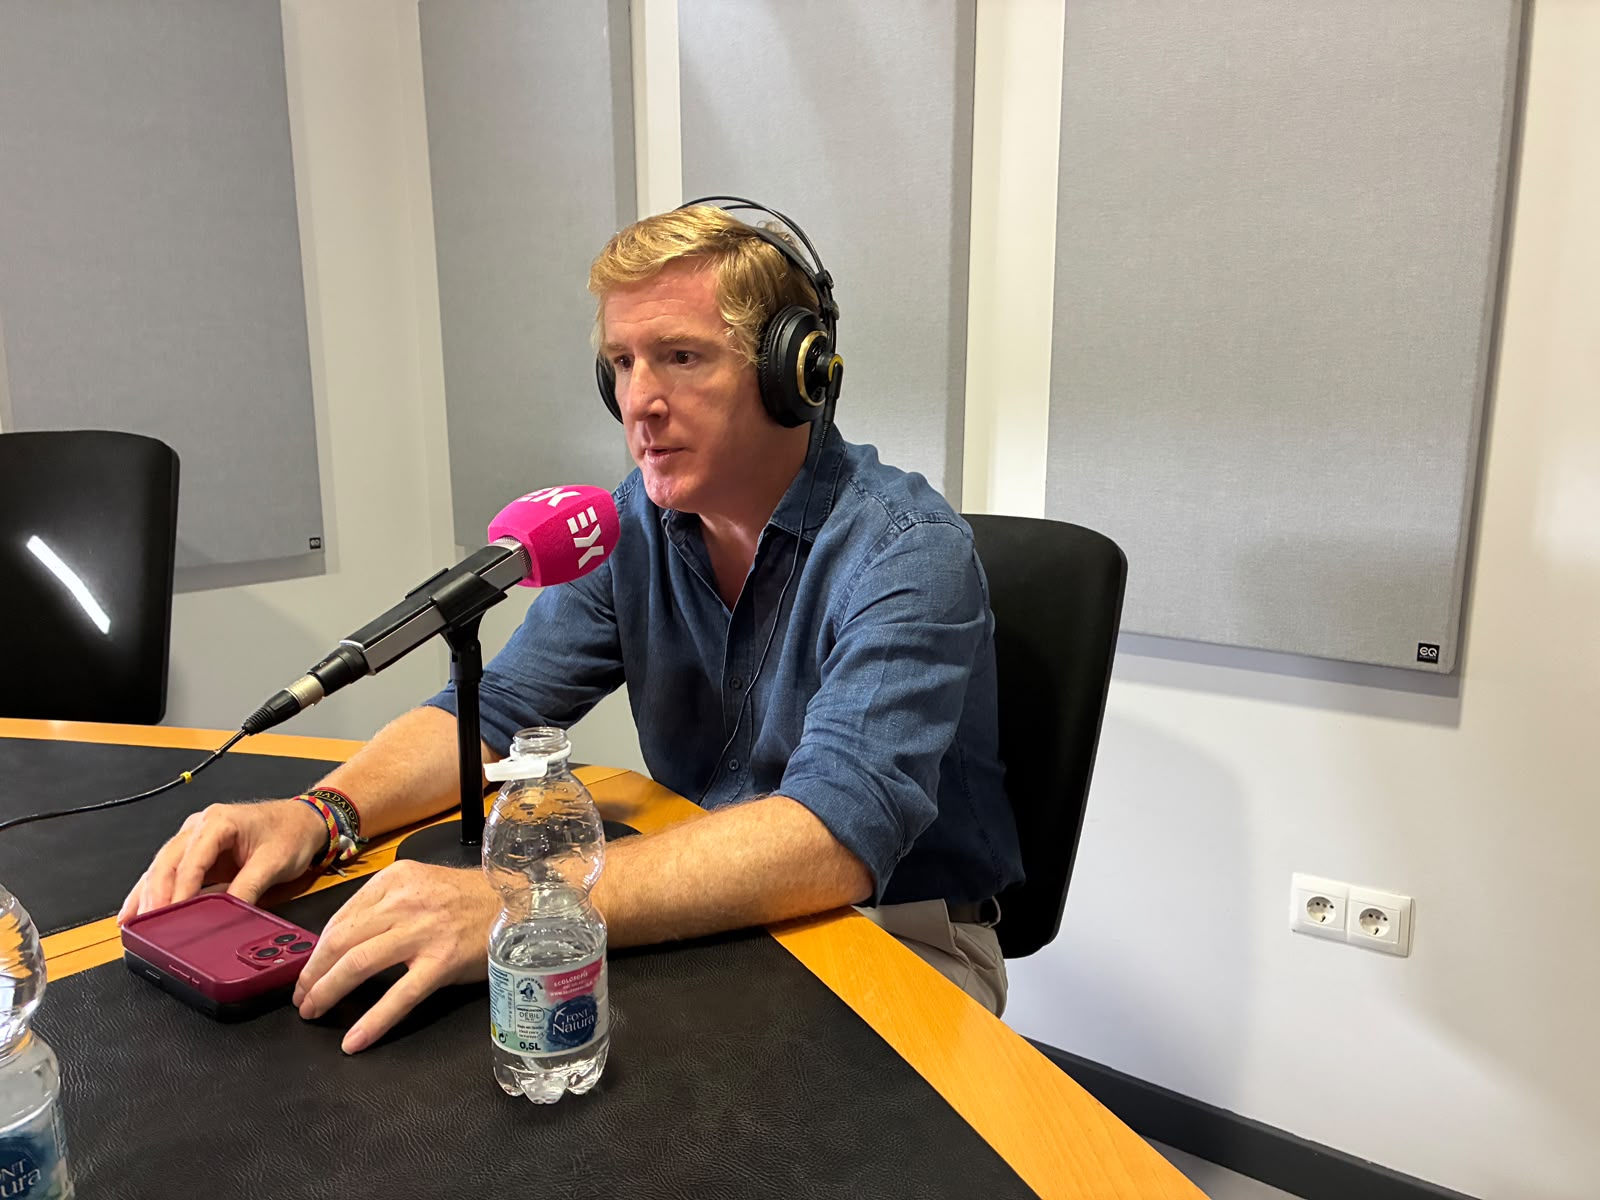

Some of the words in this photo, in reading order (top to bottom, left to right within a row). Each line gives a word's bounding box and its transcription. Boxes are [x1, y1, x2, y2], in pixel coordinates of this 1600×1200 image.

[566, 506, 604, 570] EX
[552, 1015, 594, 1035] Natura
[520, 1041, 541, 1051] 0,5L
